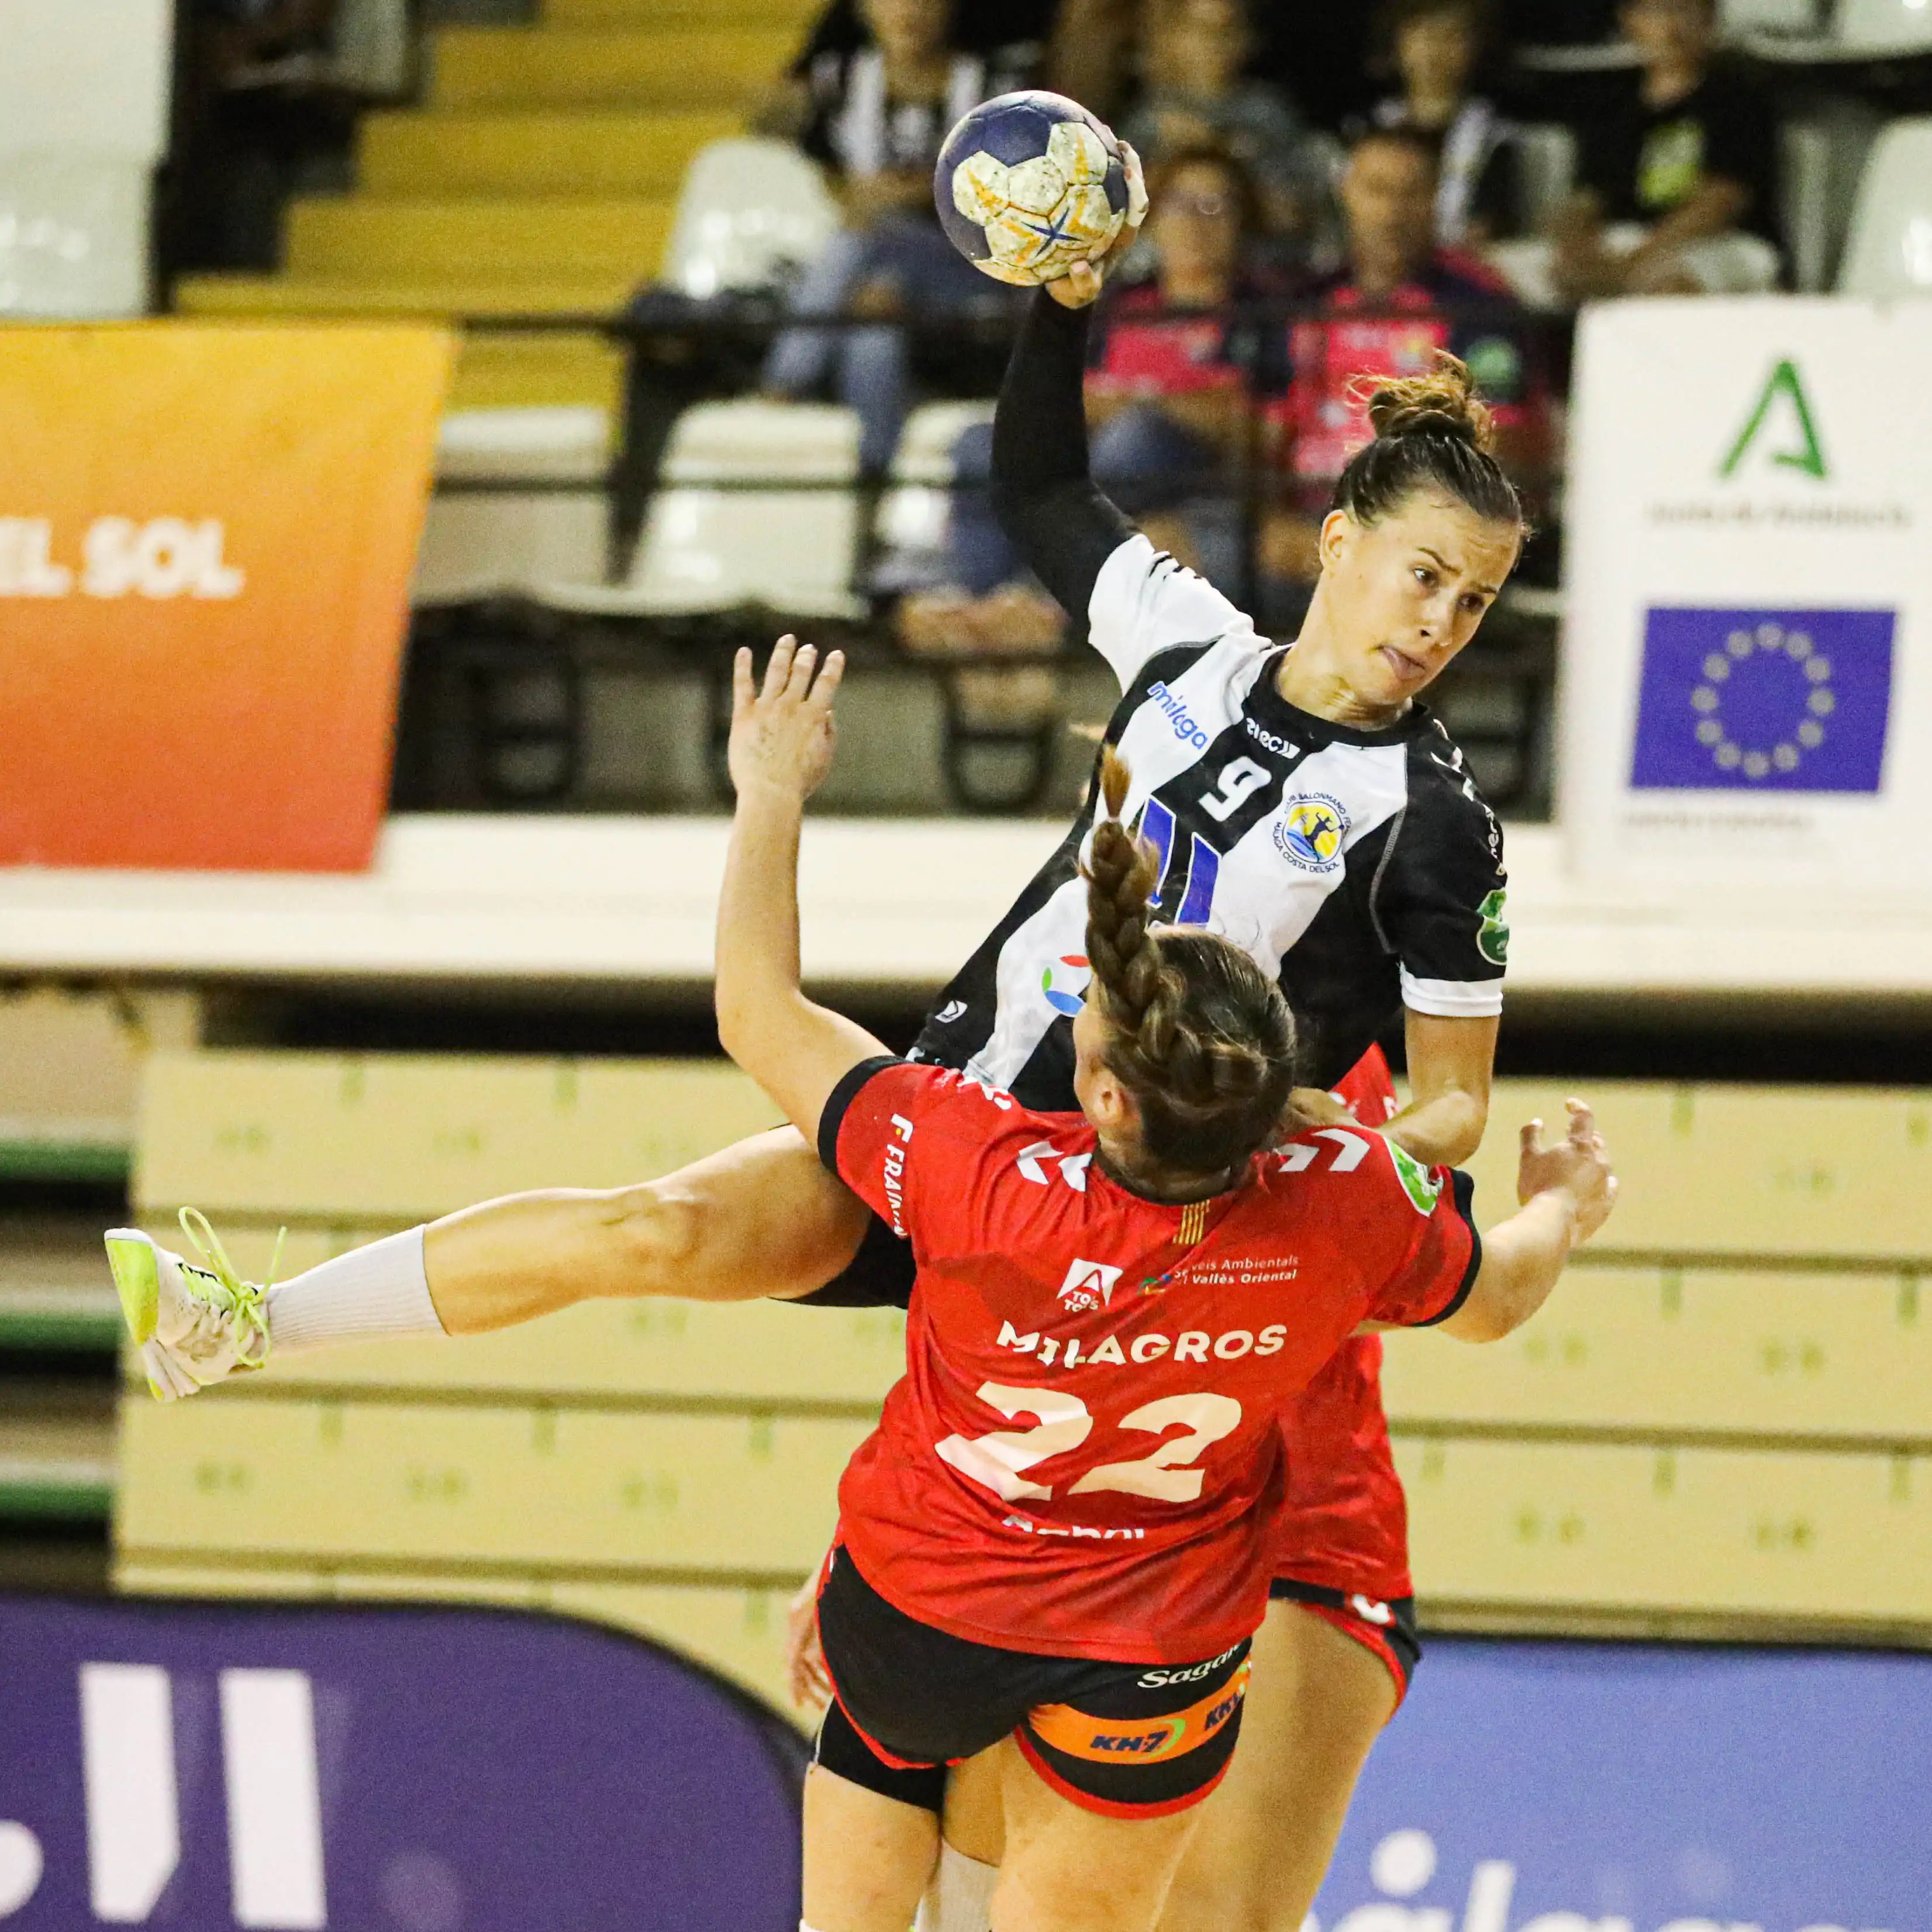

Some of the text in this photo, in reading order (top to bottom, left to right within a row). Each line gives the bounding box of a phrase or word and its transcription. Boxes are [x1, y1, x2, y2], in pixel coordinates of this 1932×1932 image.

[83, 516, 243, 599] SOL
[1198, 756, 1272, 822] 9
[1283, 852, 1307, 871] COSTA
[1325, 861, 1340, 872] SOL
[1222, 1255, 1299, 1270] Ambientals
[1241, 1269, 1297, 1284] Oriental
[996, 1320, 1287, 1368] MILAGROS
[935, 1381, 1242, 1503] 22
